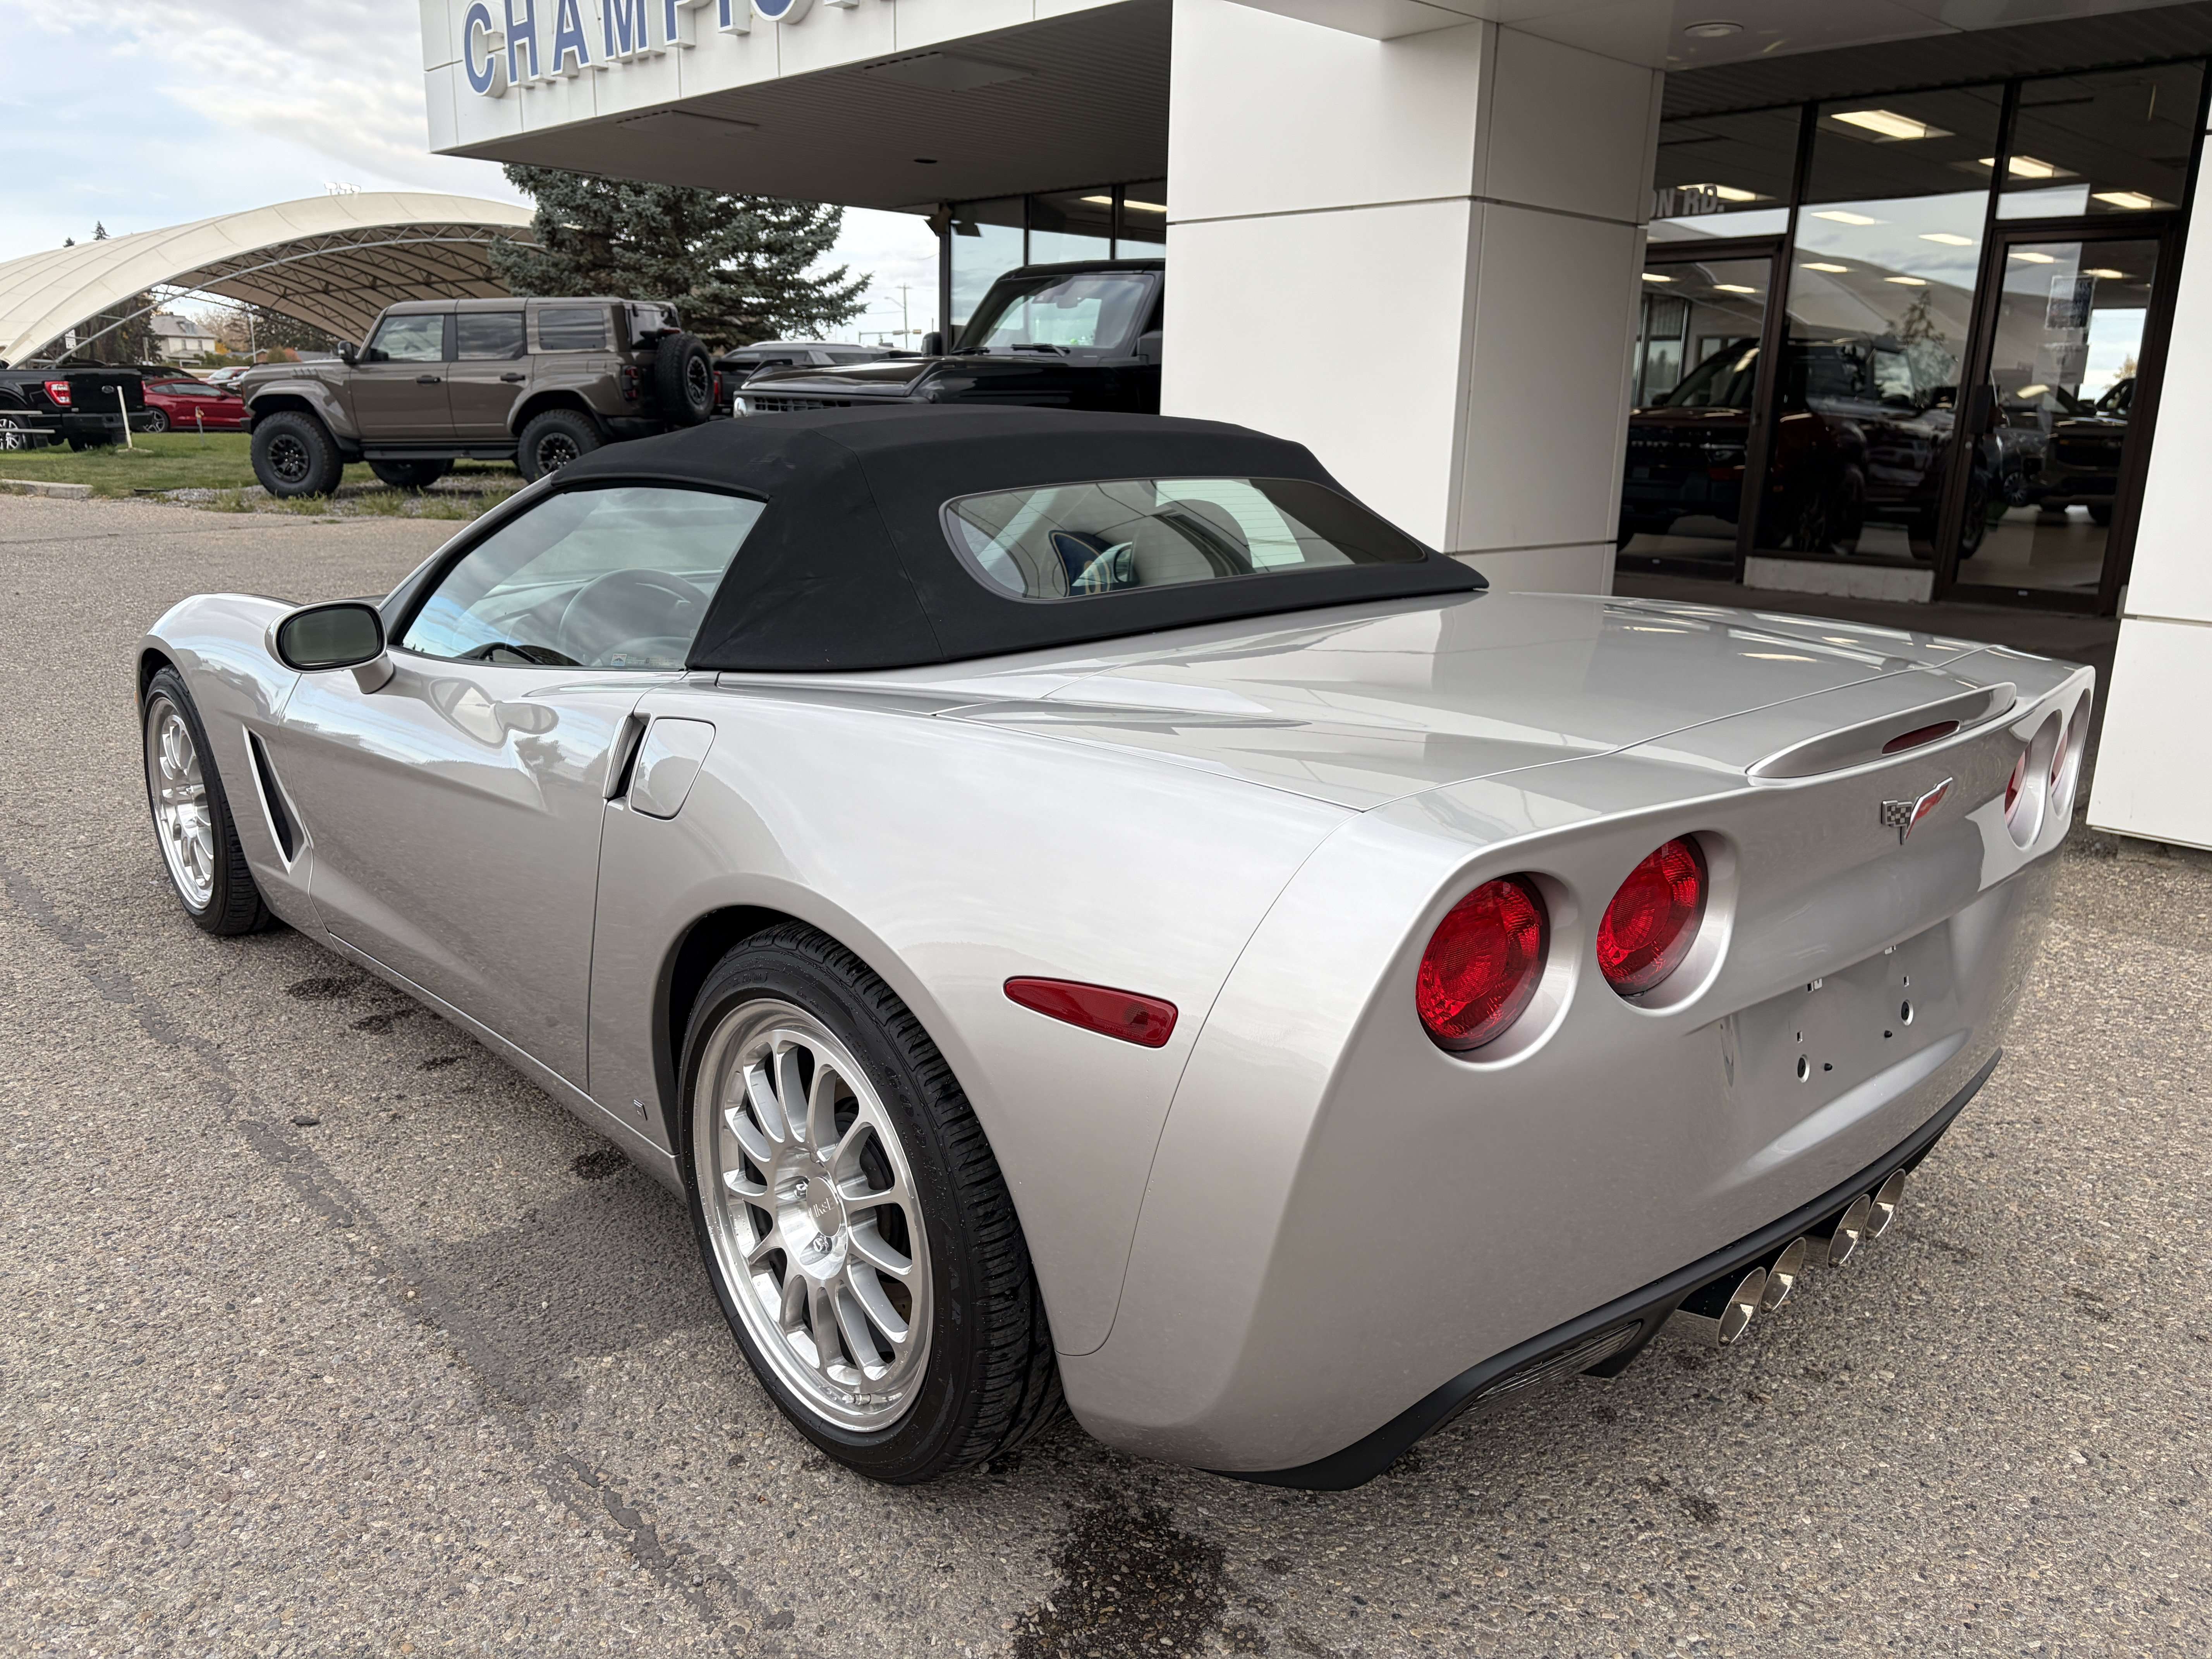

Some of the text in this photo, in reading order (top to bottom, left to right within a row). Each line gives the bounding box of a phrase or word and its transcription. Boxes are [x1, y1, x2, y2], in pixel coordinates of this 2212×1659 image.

[464, 0, 859, 97] CHAM
[1650, 184, 1724, 219] N RD.
